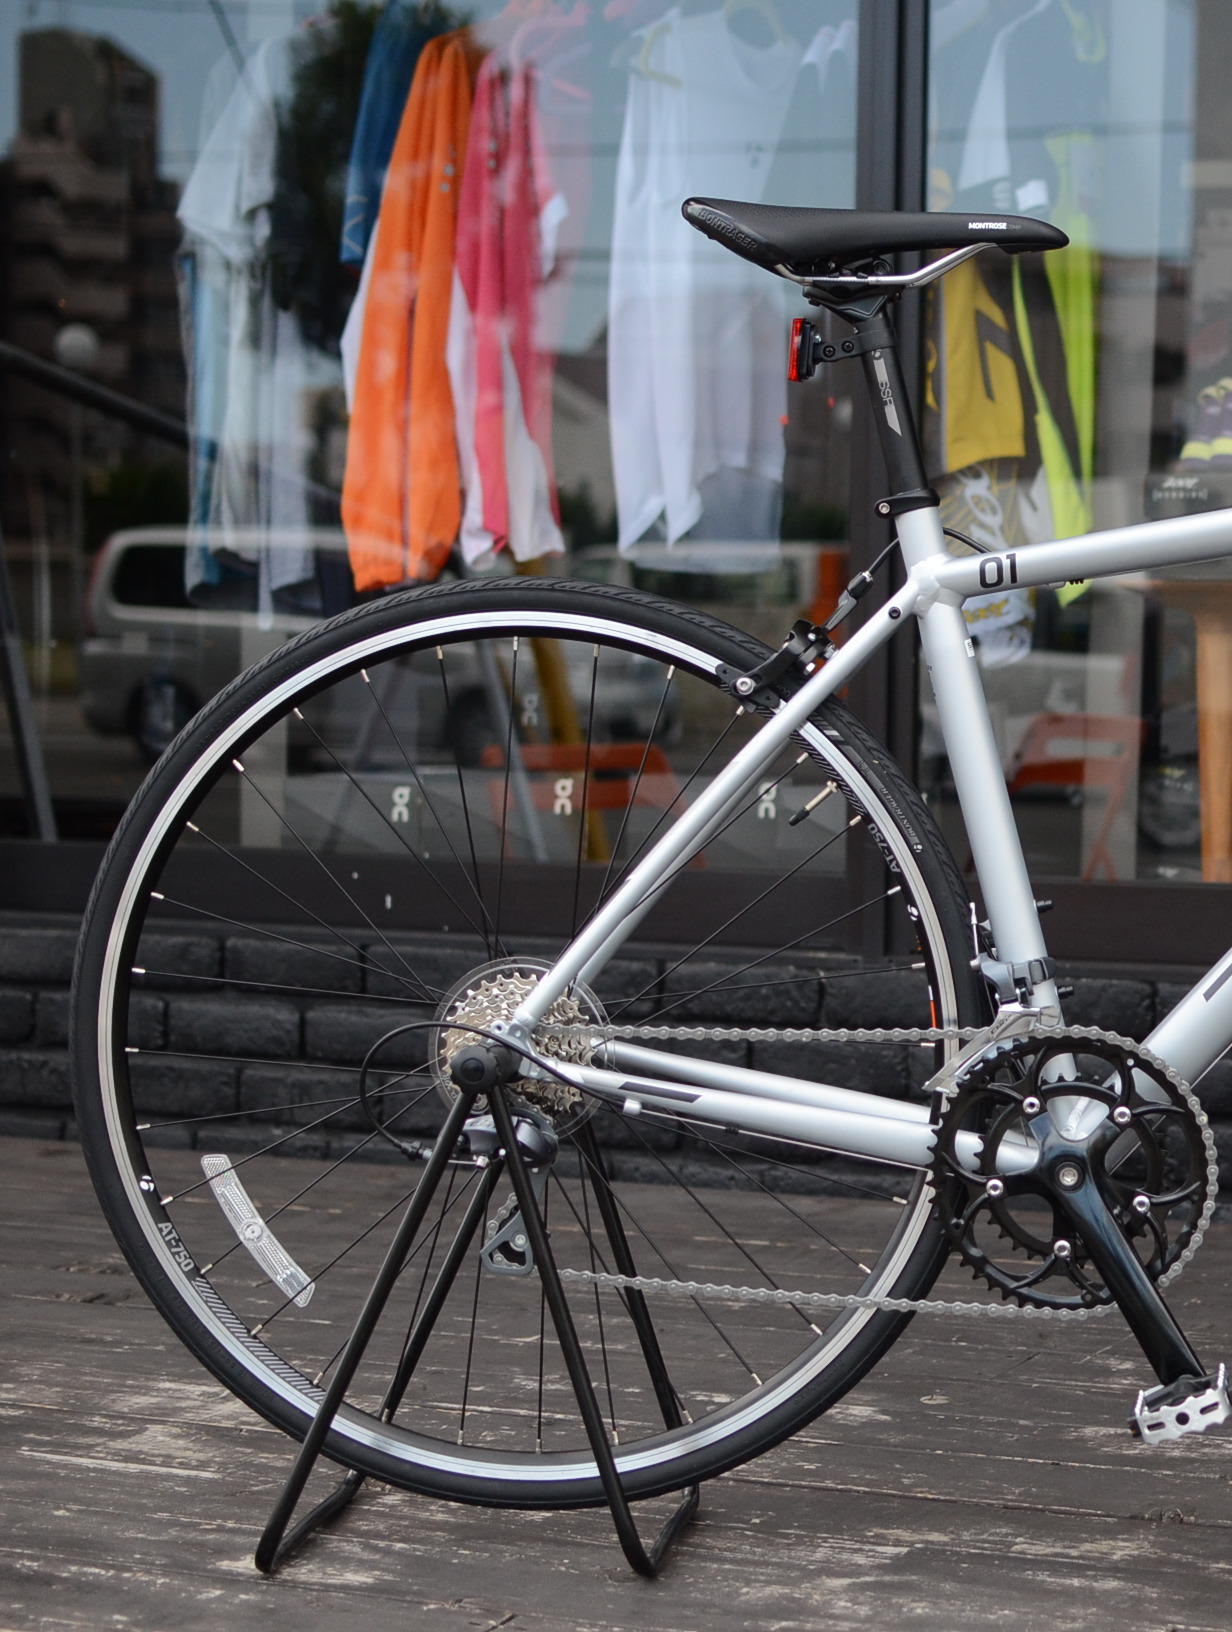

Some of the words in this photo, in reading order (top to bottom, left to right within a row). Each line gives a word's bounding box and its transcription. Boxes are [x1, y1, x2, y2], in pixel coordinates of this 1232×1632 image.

[698, 209, 758, 251] BONTRAGER
[968, 222, 1007, 230] MONTROSE
[979, 553, 1018, 589] 01
[867, 823, 901, 873] AT-750
[158, 1222, 194, 1272] AT-750
